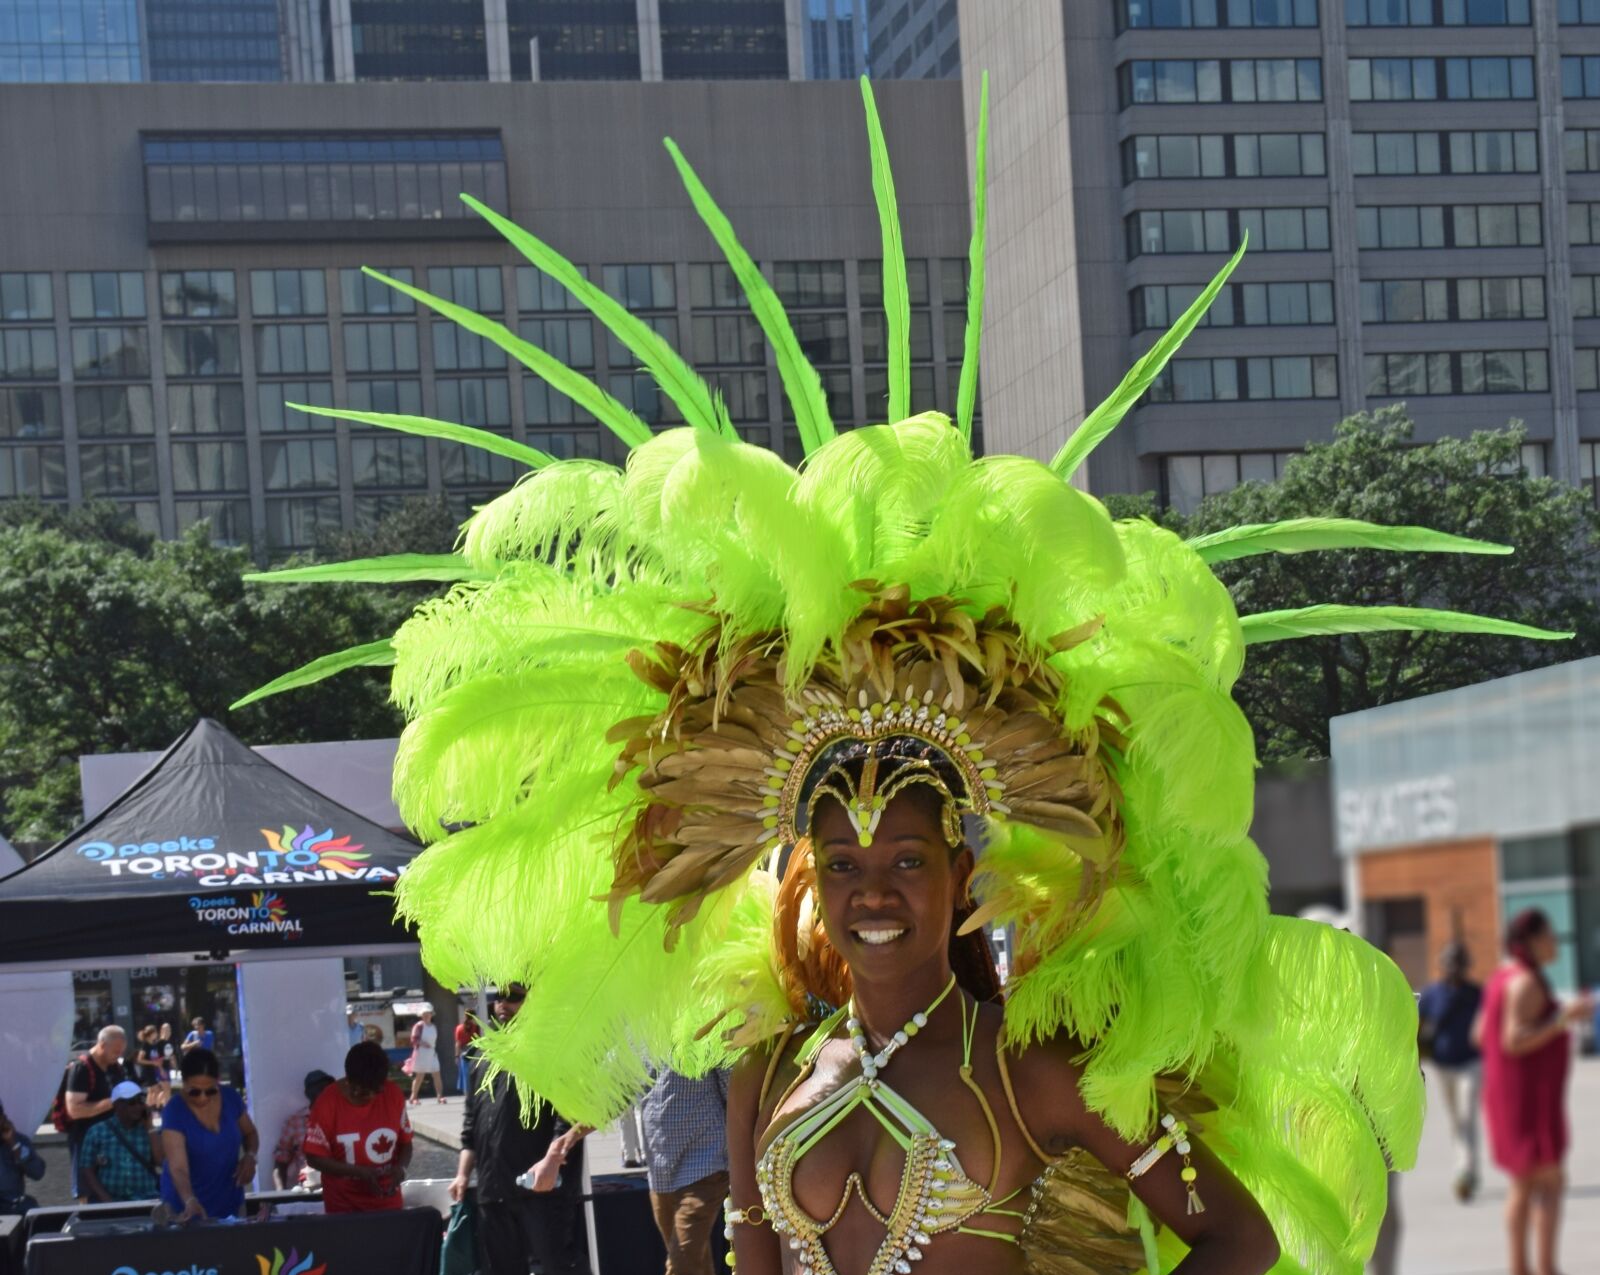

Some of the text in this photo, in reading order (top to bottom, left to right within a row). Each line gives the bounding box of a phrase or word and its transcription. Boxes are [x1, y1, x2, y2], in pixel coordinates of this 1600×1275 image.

[118, 836, 217, 857] peeks
[101, 850, 319, 876] TORONTO
[202, 897, 236, 908] peeks
[196, 907, 270, 921] TORONTO
[228, 919, 303, 935] CARNIVAL
[337, 1127, 398, 1166] TO
